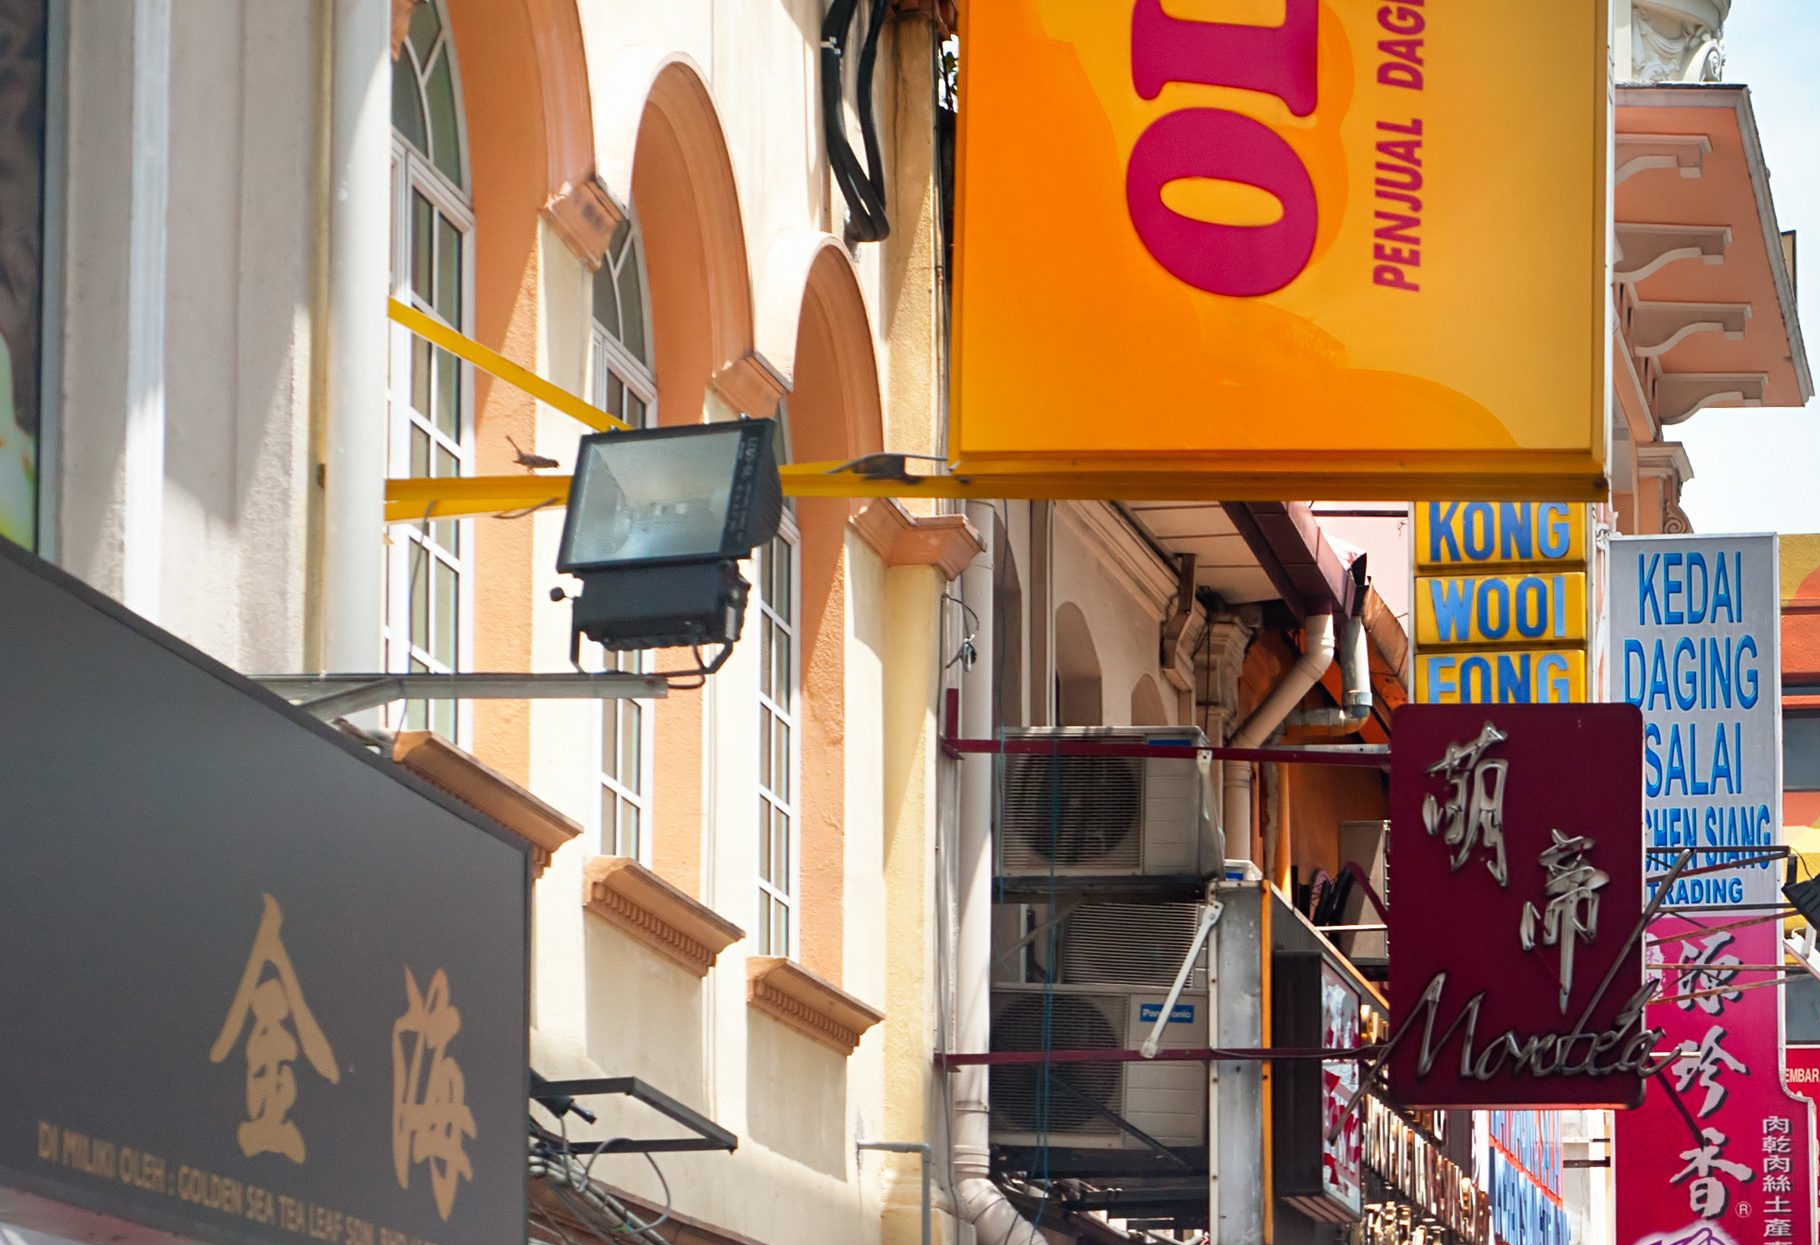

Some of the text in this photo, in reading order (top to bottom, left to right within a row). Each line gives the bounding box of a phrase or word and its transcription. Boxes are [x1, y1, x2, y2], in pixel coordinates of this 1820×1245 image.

[1373, 117, 1425, 293] PENJUAL
[1430, 502, 1570, 561] KONG
[1430, 576, 1567, 641] WOOI
[1638, 551, 1742, 626] KEDAI
[1624, 634, 1759, 711] DAGING
[1646, 721, 1742, 797] SALAI
[1705, 804, 1771, 870] SIANG
[1647, 877, 1743, 905] TRADING
[118, 1146, 168, 1195] OLEH
[177, 1164, 245, 1216] GOLDEN
[245, 1185, 275, 1226] SEA
[278, 1194, 307, 1234] TEA
[308, 1203, 343, 1244] LEAF
